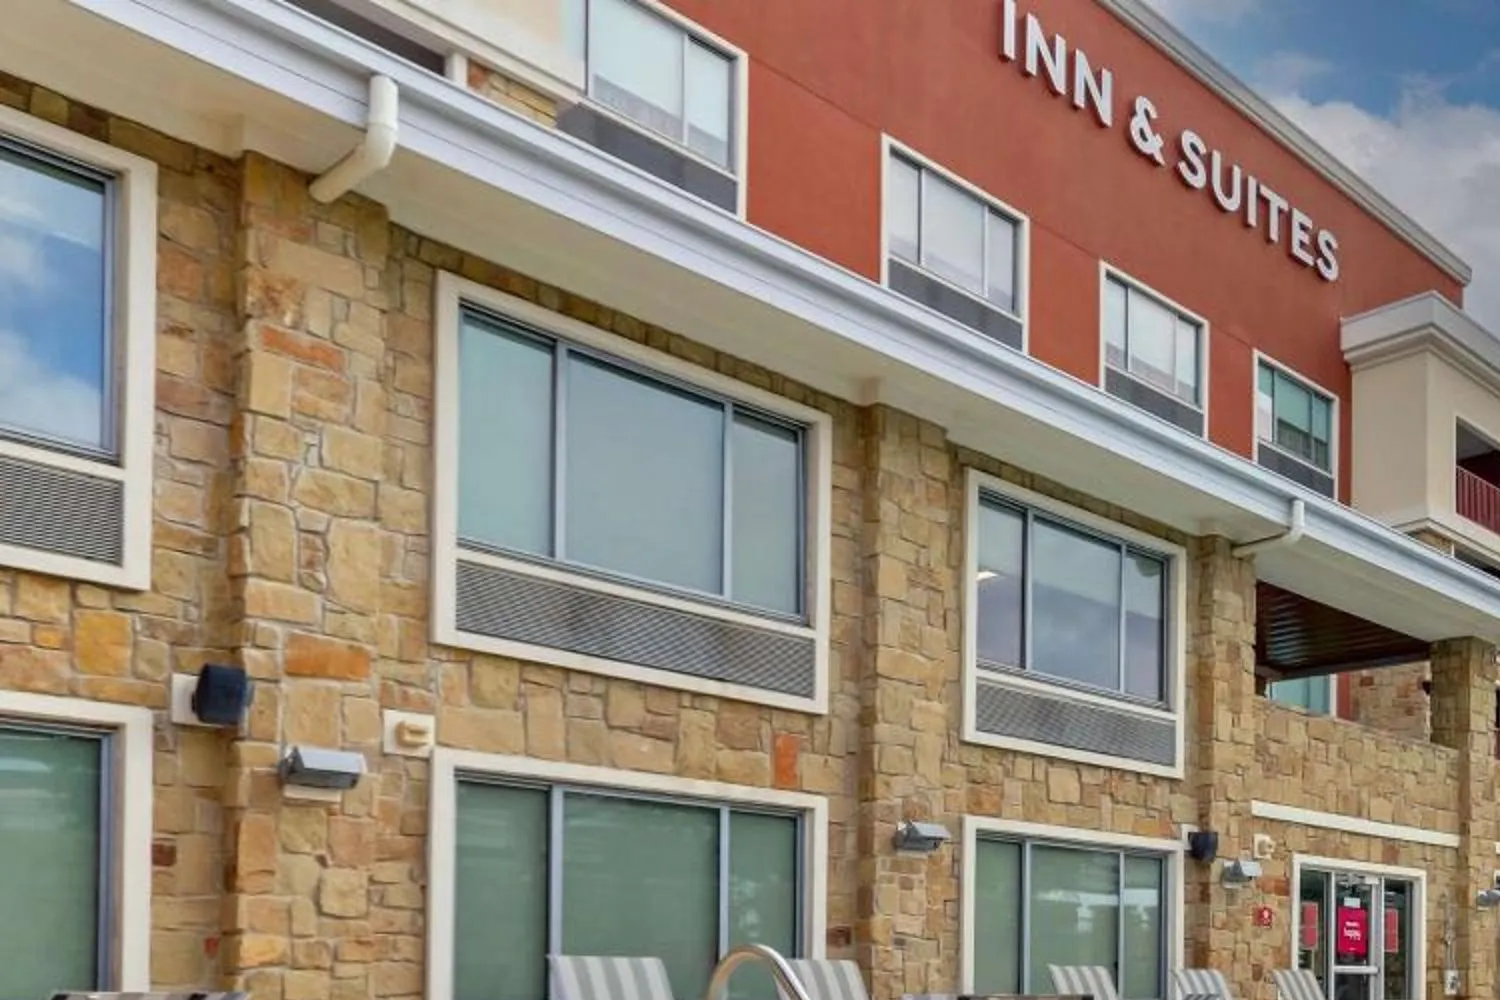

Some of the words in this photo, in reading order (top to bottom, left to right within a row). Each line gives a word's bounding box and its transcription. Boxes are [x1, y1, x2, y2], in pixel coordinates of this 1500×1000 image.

[999, 0, 1112, 127] INN
[1130, 95, 1164, 166] &
[1177, 129, 1340, 282] SUITES
